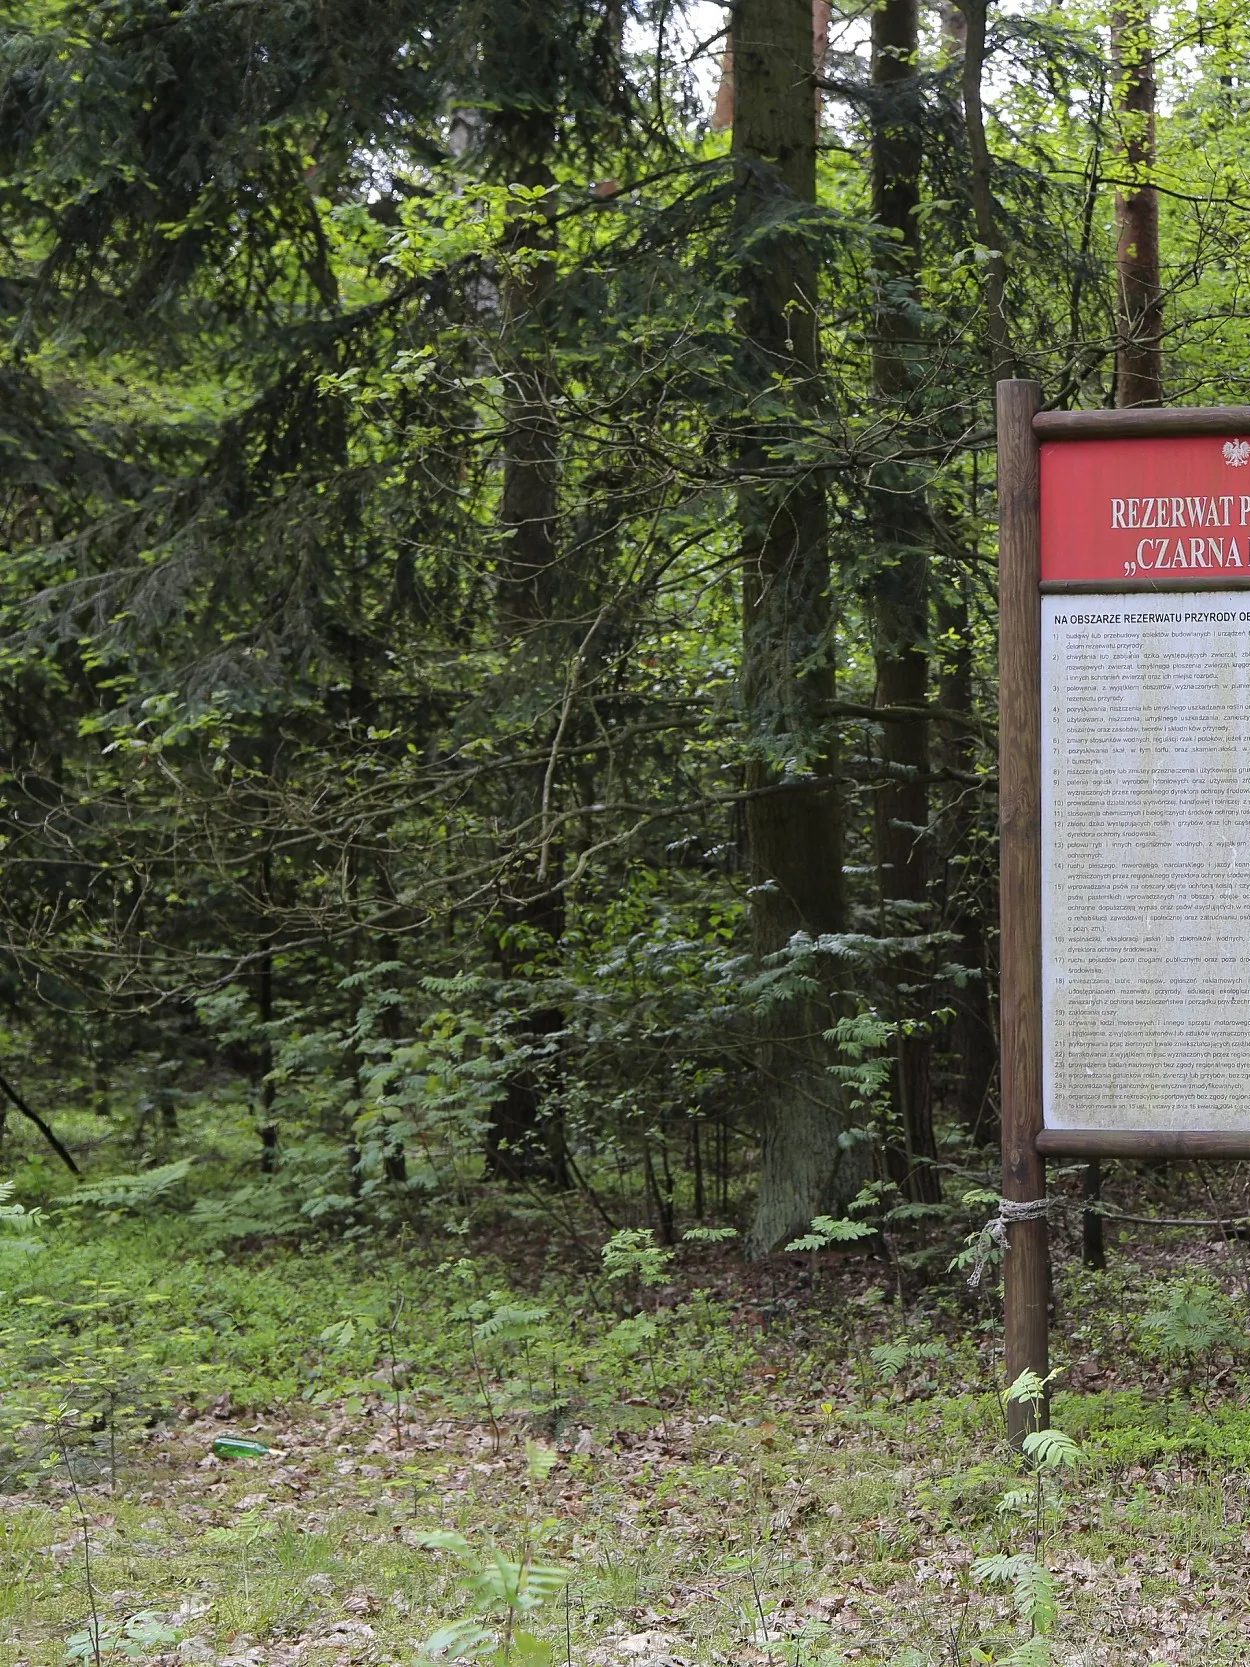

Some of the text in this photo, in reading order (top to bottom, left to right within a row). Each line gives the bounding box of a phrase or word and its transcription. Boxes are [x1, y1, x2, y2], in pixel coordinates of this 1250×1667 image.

[1110, 496, 1235, 529] REZERWAT
[1054, 615, 1068, 625] NA
[1070, 614, 1122, 625] OBSZARZE
[1123, 612, 1182, 624] REZERWATU
[1184, 612, 1237, 623] PRZYRODY
